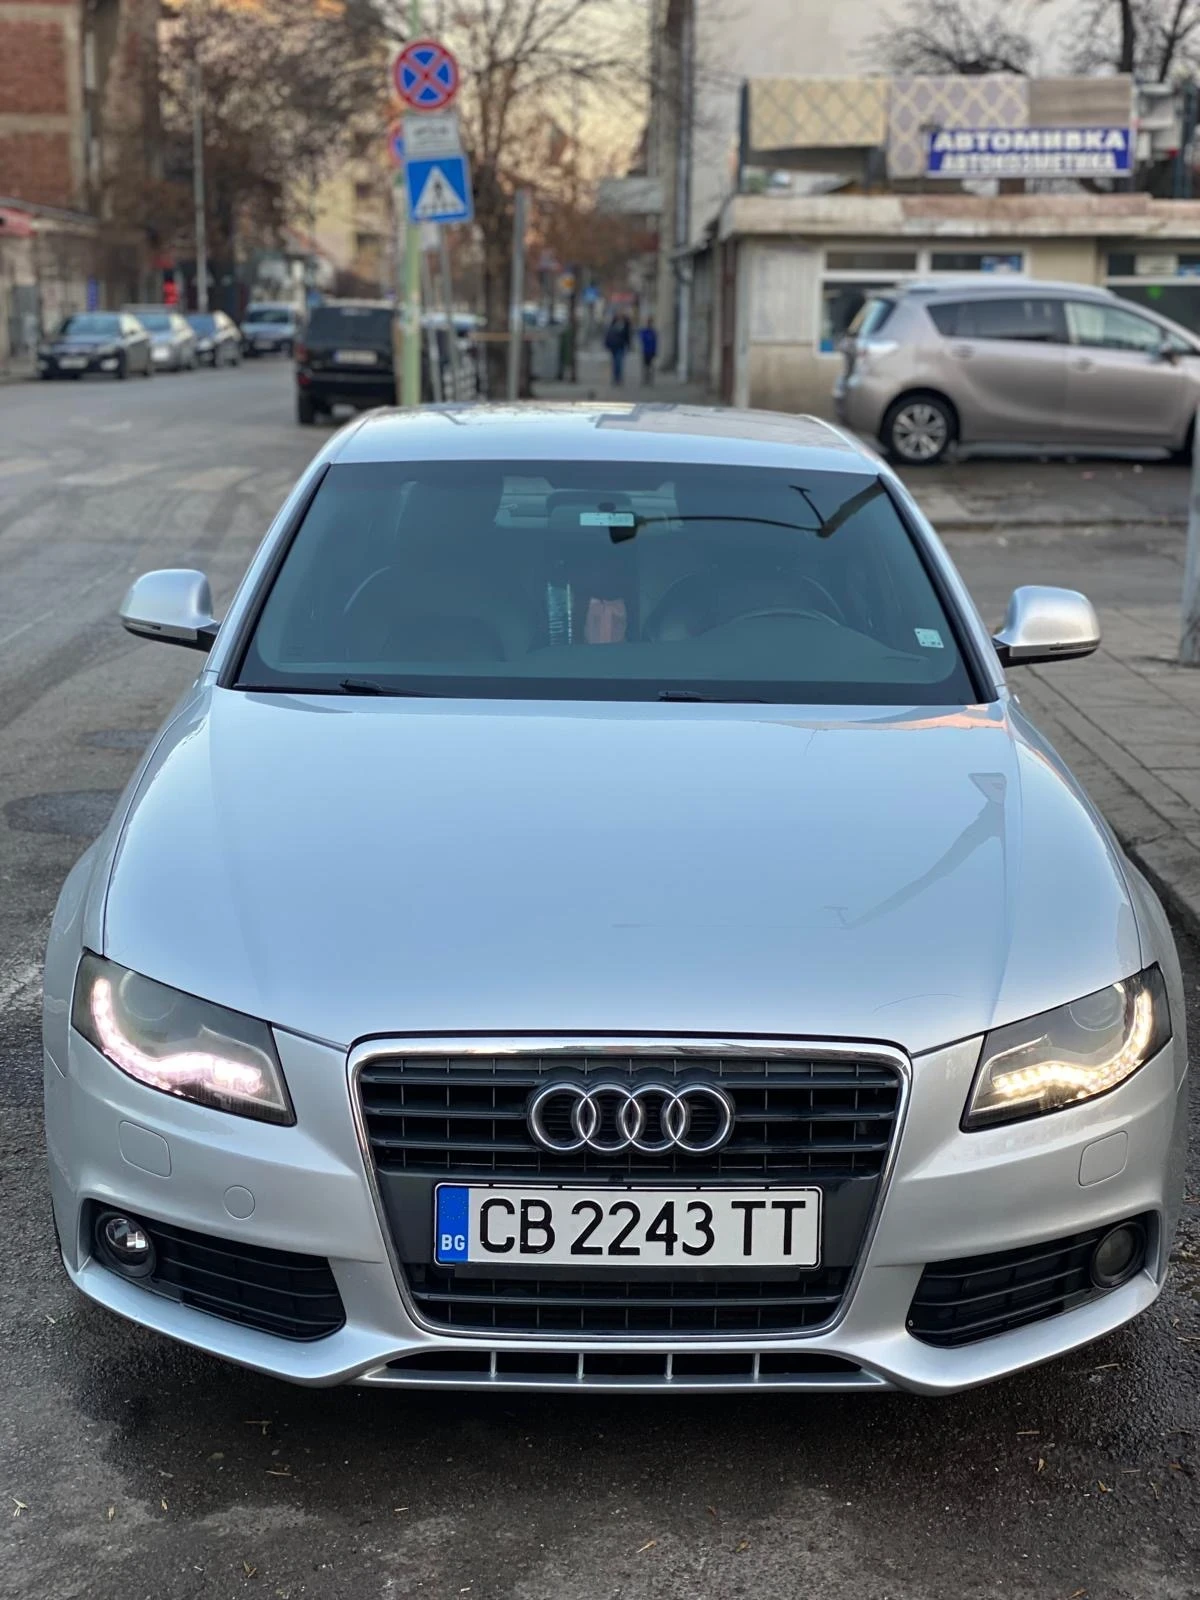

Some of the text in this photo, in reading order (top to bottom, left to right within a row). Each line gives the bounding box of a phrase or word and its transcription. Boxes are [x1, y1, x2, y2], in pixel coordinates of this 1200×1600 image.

[932, 130, 1126, 151] АВТОМИВКА
[479, 1197, 806, 1257] CB 2243 TT
[441, 1233, 466, 1251] BG
